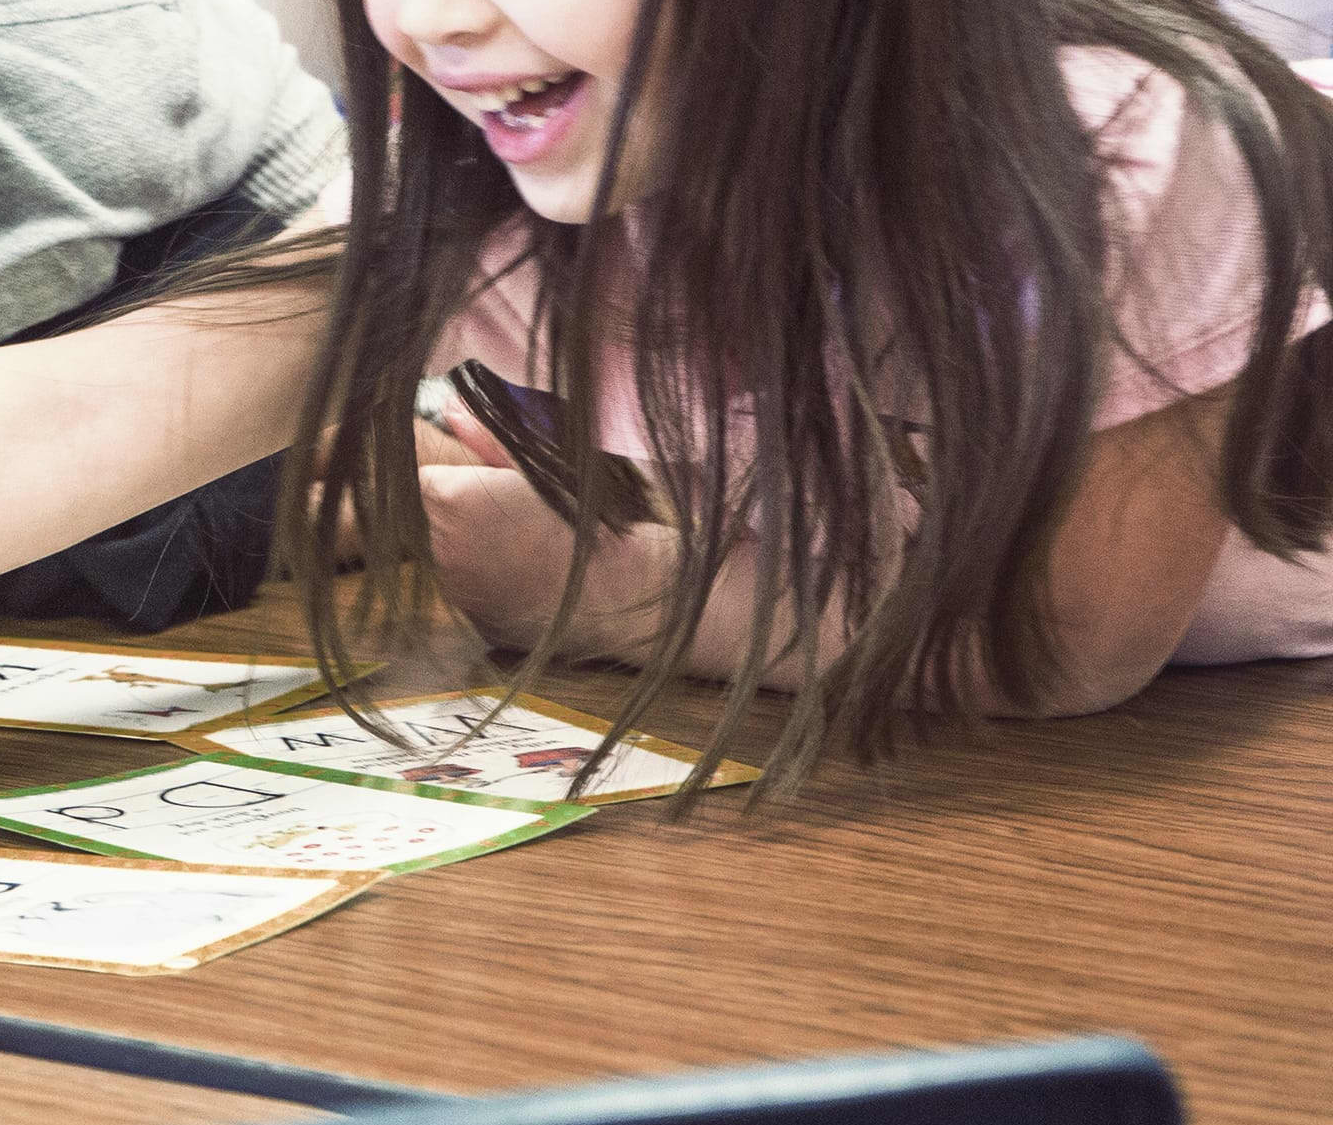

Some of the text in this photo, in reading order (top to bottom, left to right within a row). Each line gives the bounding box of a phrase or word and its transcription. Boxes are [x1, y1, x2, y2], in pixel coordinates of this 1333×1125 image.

[278, 712, 539, 751] W w
[42, 780, 287, 829] D d
